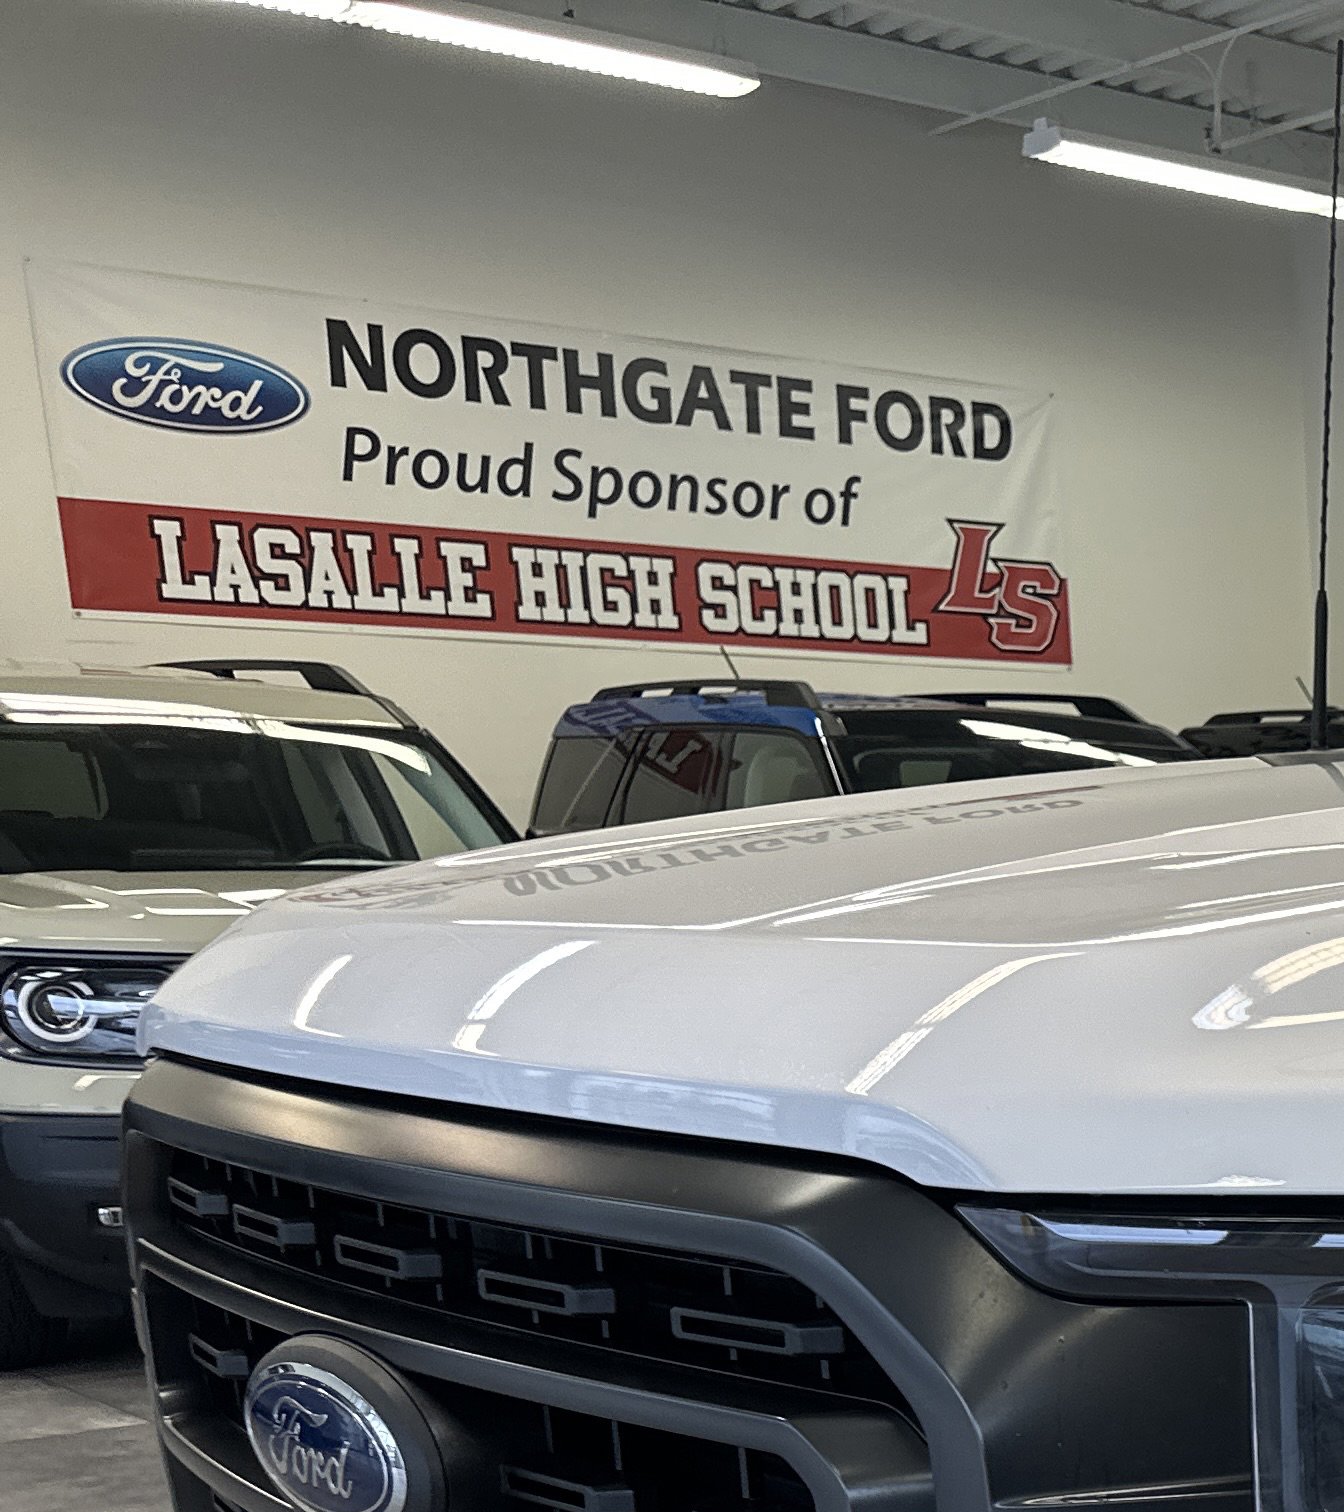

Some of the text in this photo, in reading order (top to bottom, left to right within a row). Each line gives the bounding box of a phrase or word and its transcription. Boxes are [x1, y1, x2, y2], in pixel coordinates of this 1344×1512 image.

[112, 351, 264, 421] Ford
[325, 318, 1013, 462] NORTHGATE FORD
[342, 426, 861, 526] Proud Sponsor of
[148, 514, 930, 647] LASALLE HIGH SCHOOL
[932, 517, 1061, 653] LS
[268, 1395, 353, 1499] Ford
